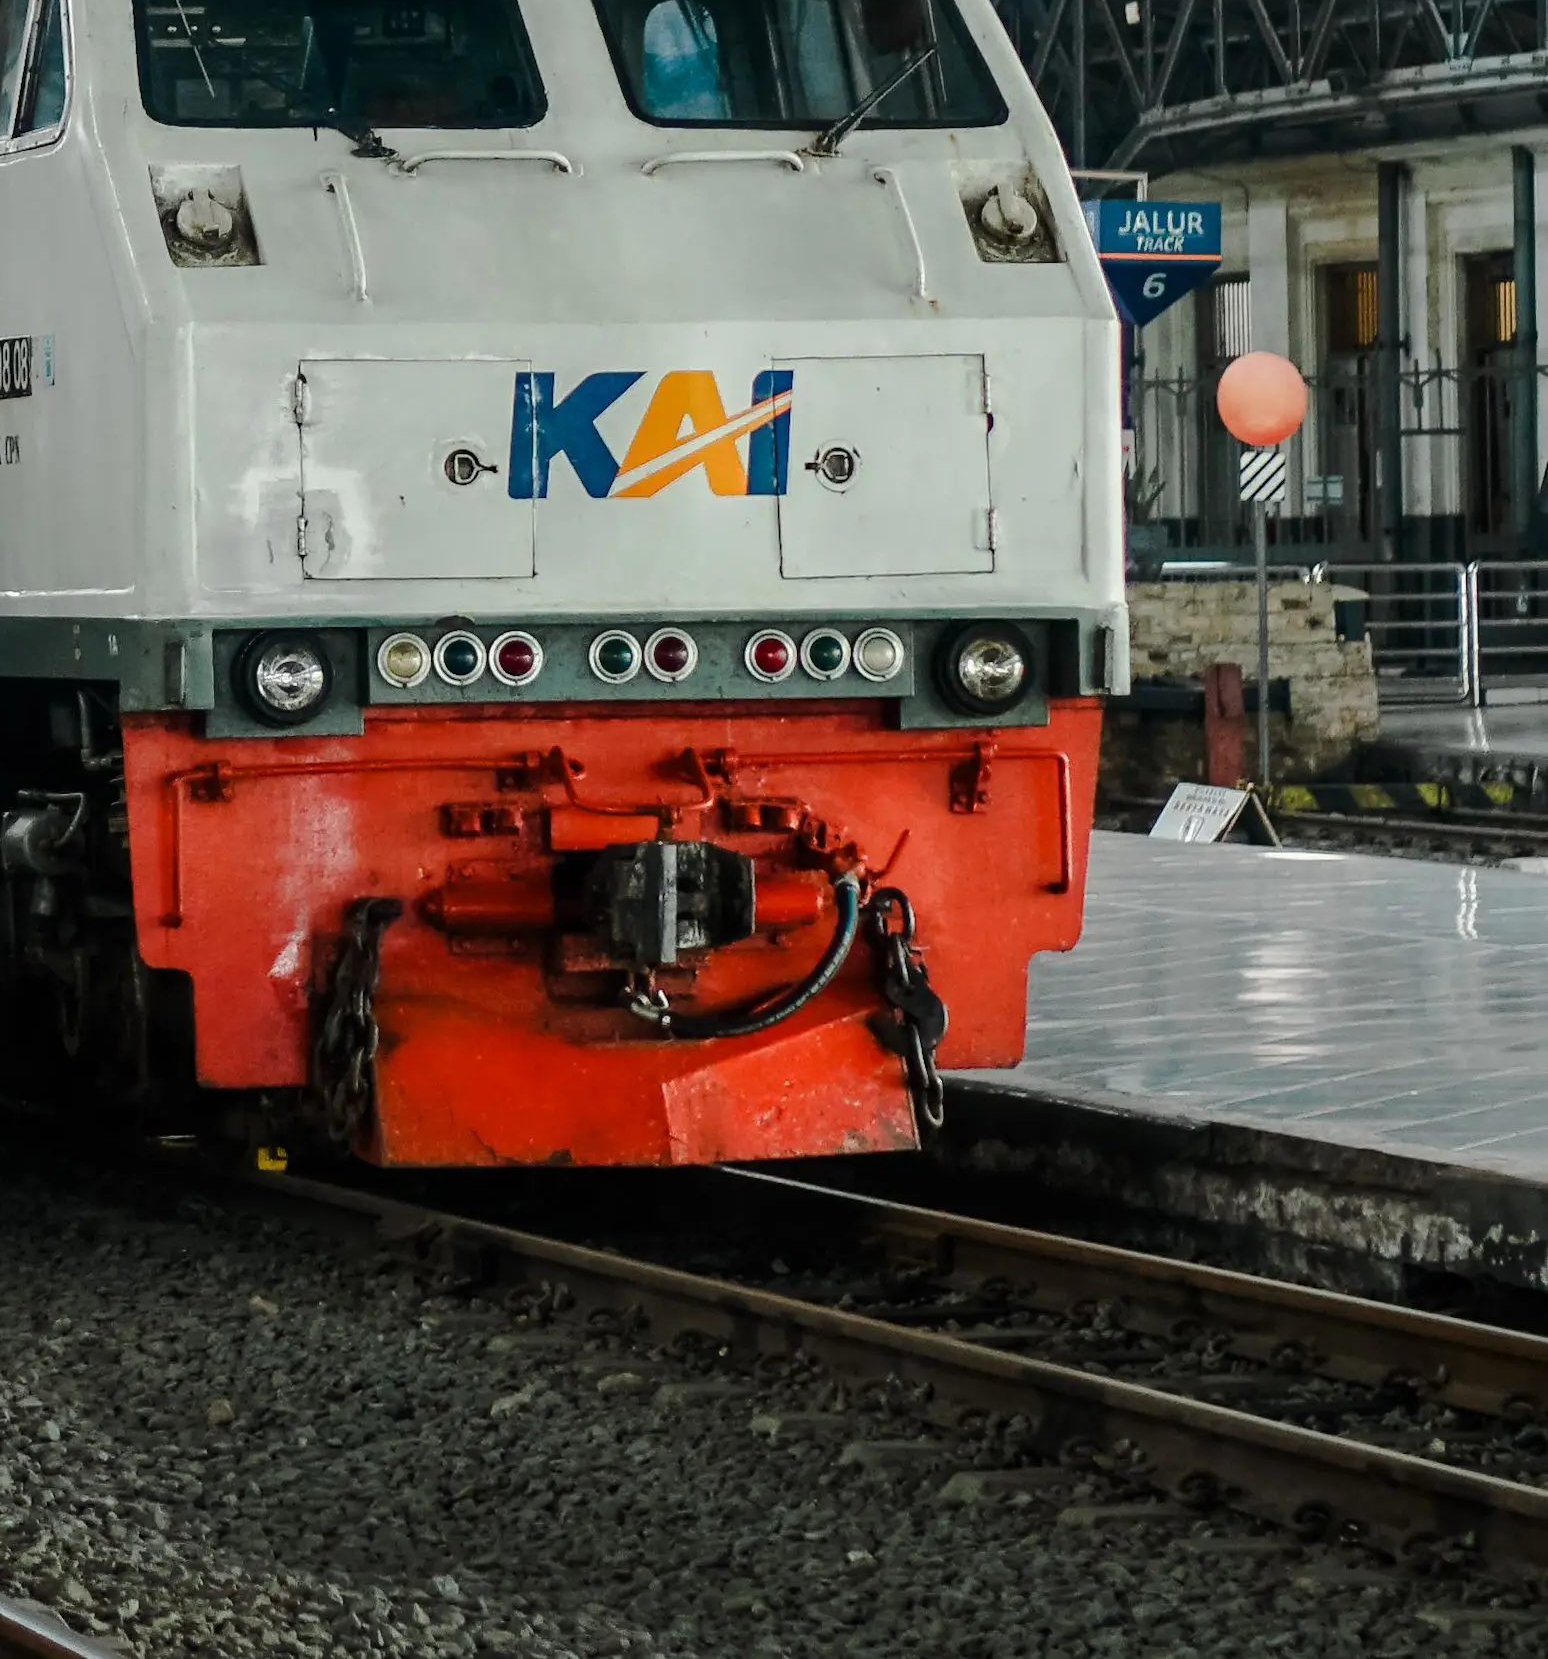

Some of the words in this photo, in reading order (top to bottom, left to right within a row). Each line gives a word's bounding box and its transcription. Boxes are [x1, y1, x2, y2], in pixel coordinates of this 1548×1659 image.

[1118, 210, 1204, 235] JALUR
[1137, 235, 1185, 253] TRACK
[1142, 273, 1167, 299] 6
[13, 338, 28, 391] 08
[507, 370, 794, 499] KAI
